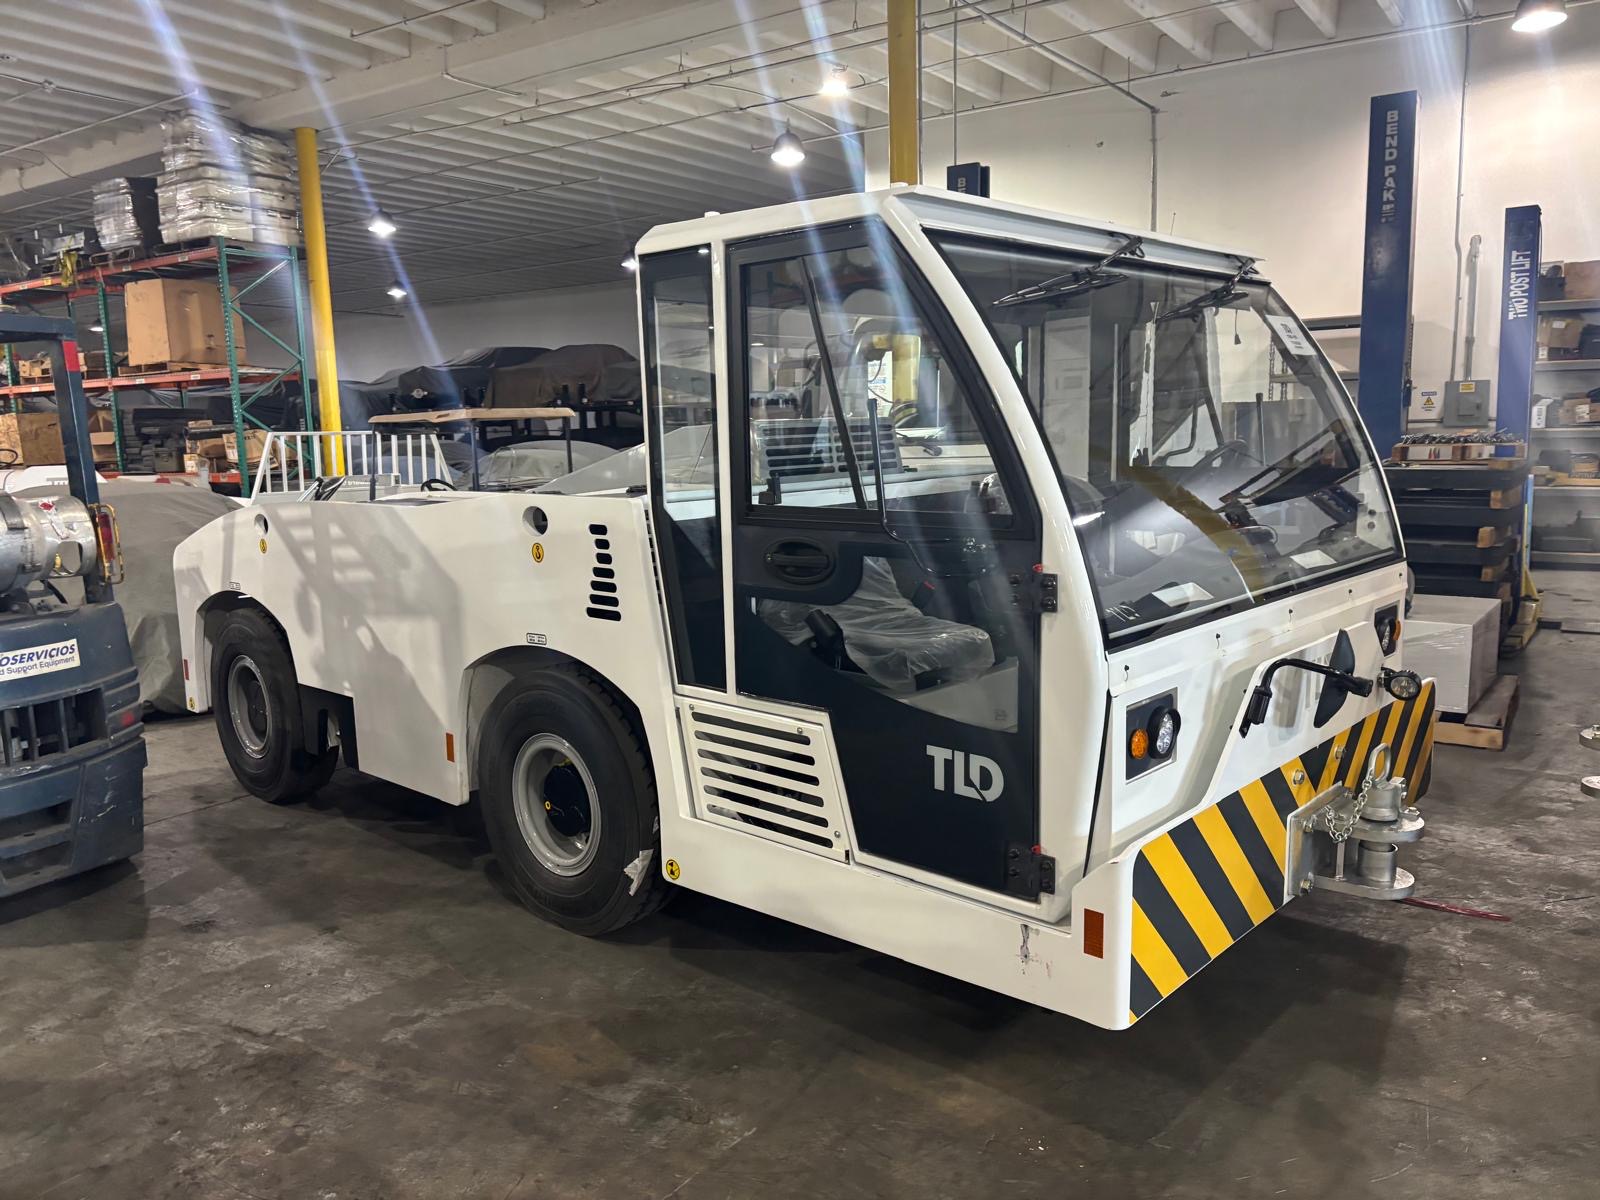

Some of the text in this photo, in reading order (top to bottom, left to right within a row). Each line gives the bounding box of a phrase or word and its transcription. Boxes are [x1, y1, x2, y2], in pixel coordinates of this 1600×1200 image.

[1510, 250, 1531, 270] LIFT
[1509, 271, 1530, 297] POST
[0, 644, 75, 667] OSERVICIOS
[7, 663, 38, 675] Support
[40, 656, 75, 669] Equipment
[926, 744, 1004, 802] TLD
